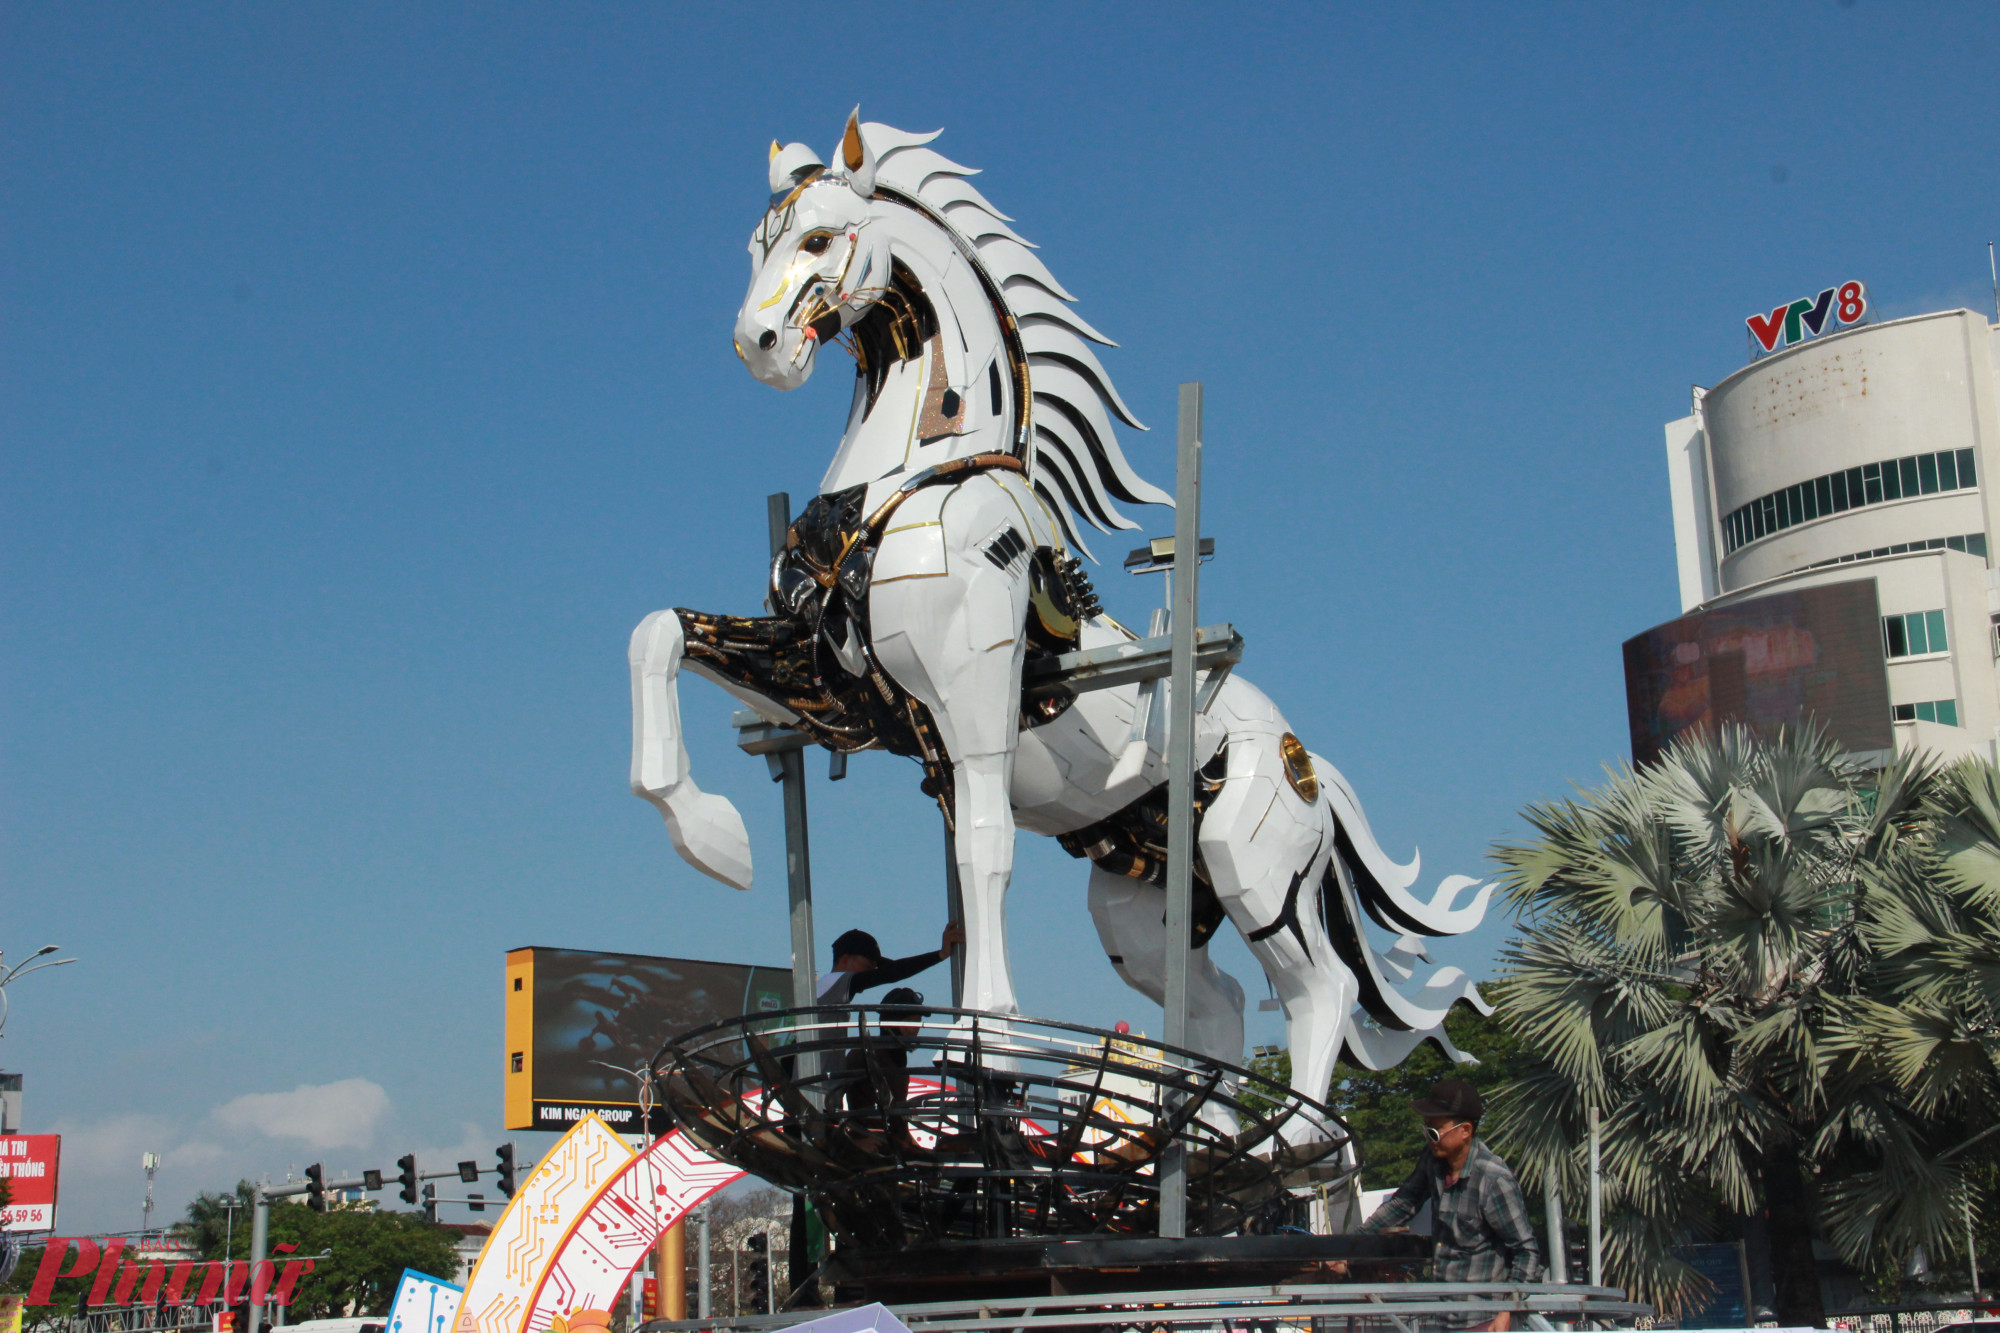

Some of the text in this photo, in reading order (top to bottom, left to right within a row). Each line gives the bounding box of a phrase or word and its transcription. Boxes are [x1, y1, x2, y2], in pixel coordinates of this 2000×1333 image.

[1745, 280, 1867, 352] VTV8
[541, 1107, 562, 1120] KIM
[597, 1109, 633, 1122] GROUP
[11, 1140, 28, 1158] TRỊ
[15, 1209, 28, 1223] 59
[30, 1209, 43, 1222] 56
